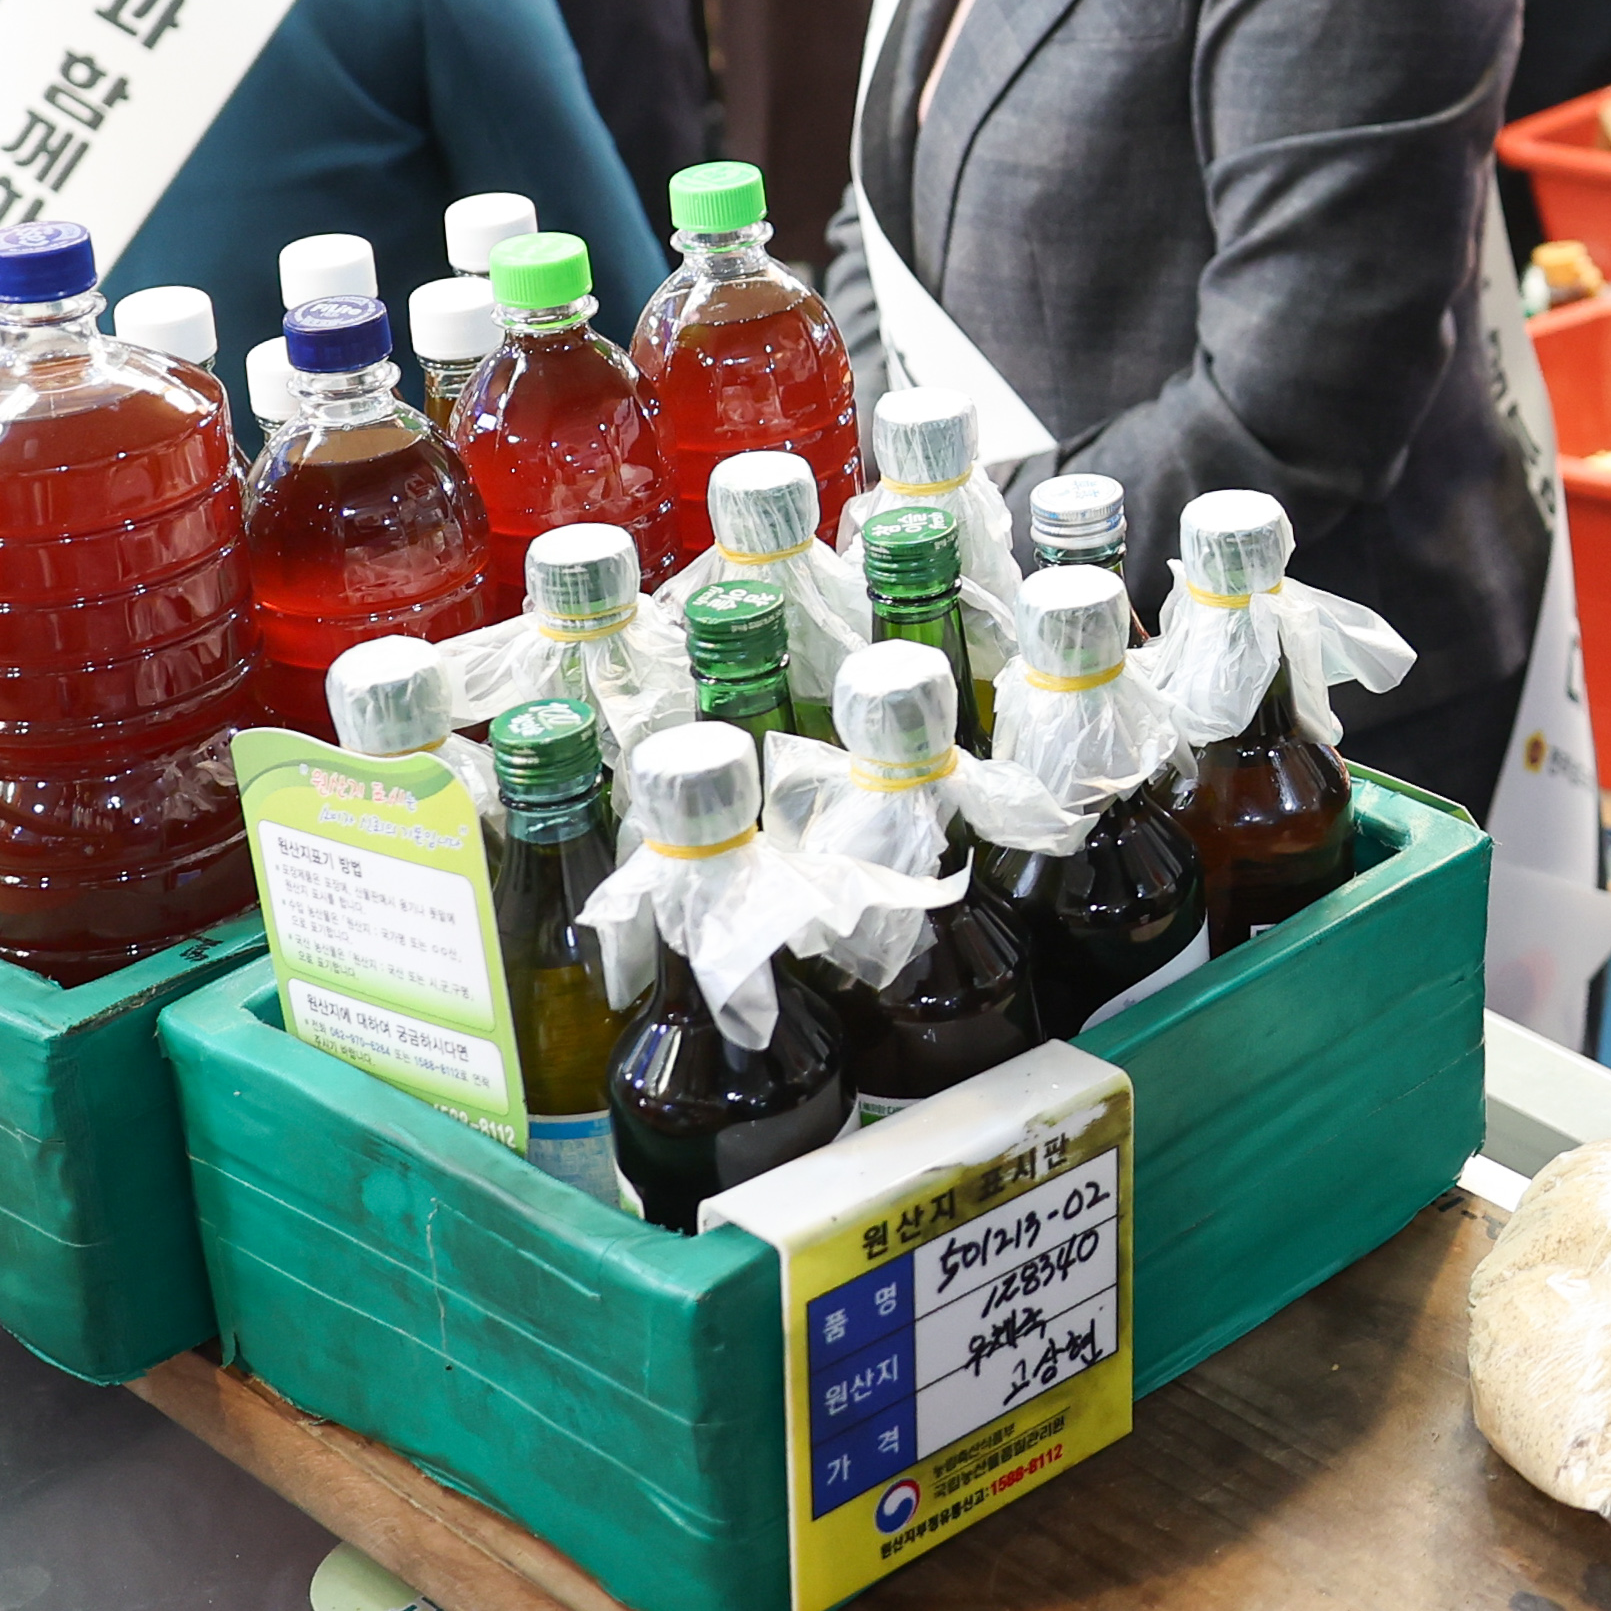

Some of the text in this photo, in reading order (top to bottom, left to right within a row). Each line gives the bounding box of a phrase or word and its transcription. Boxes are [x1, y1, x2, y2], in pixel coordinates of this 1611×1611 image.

[278, 837, 363, 878] 원산지표기 방법
[306, 993, 469, 1062] 원산지에 대하여 궁금하시다면
[862, 1133, 1069, 1264] 원산지 표시판
[937, 1181, 1110, 1293] 501213-02
[981, 1227, 1100, 1319] 128340
[824, 1352, 899, 1419] 원산지
[933, 1422, 1016, 1478] 농림축산식품부
[933, 1415, 1066, 1499] 국립농산물품질관리원
[990, 1443, 1063, 1496] 1588-8112
